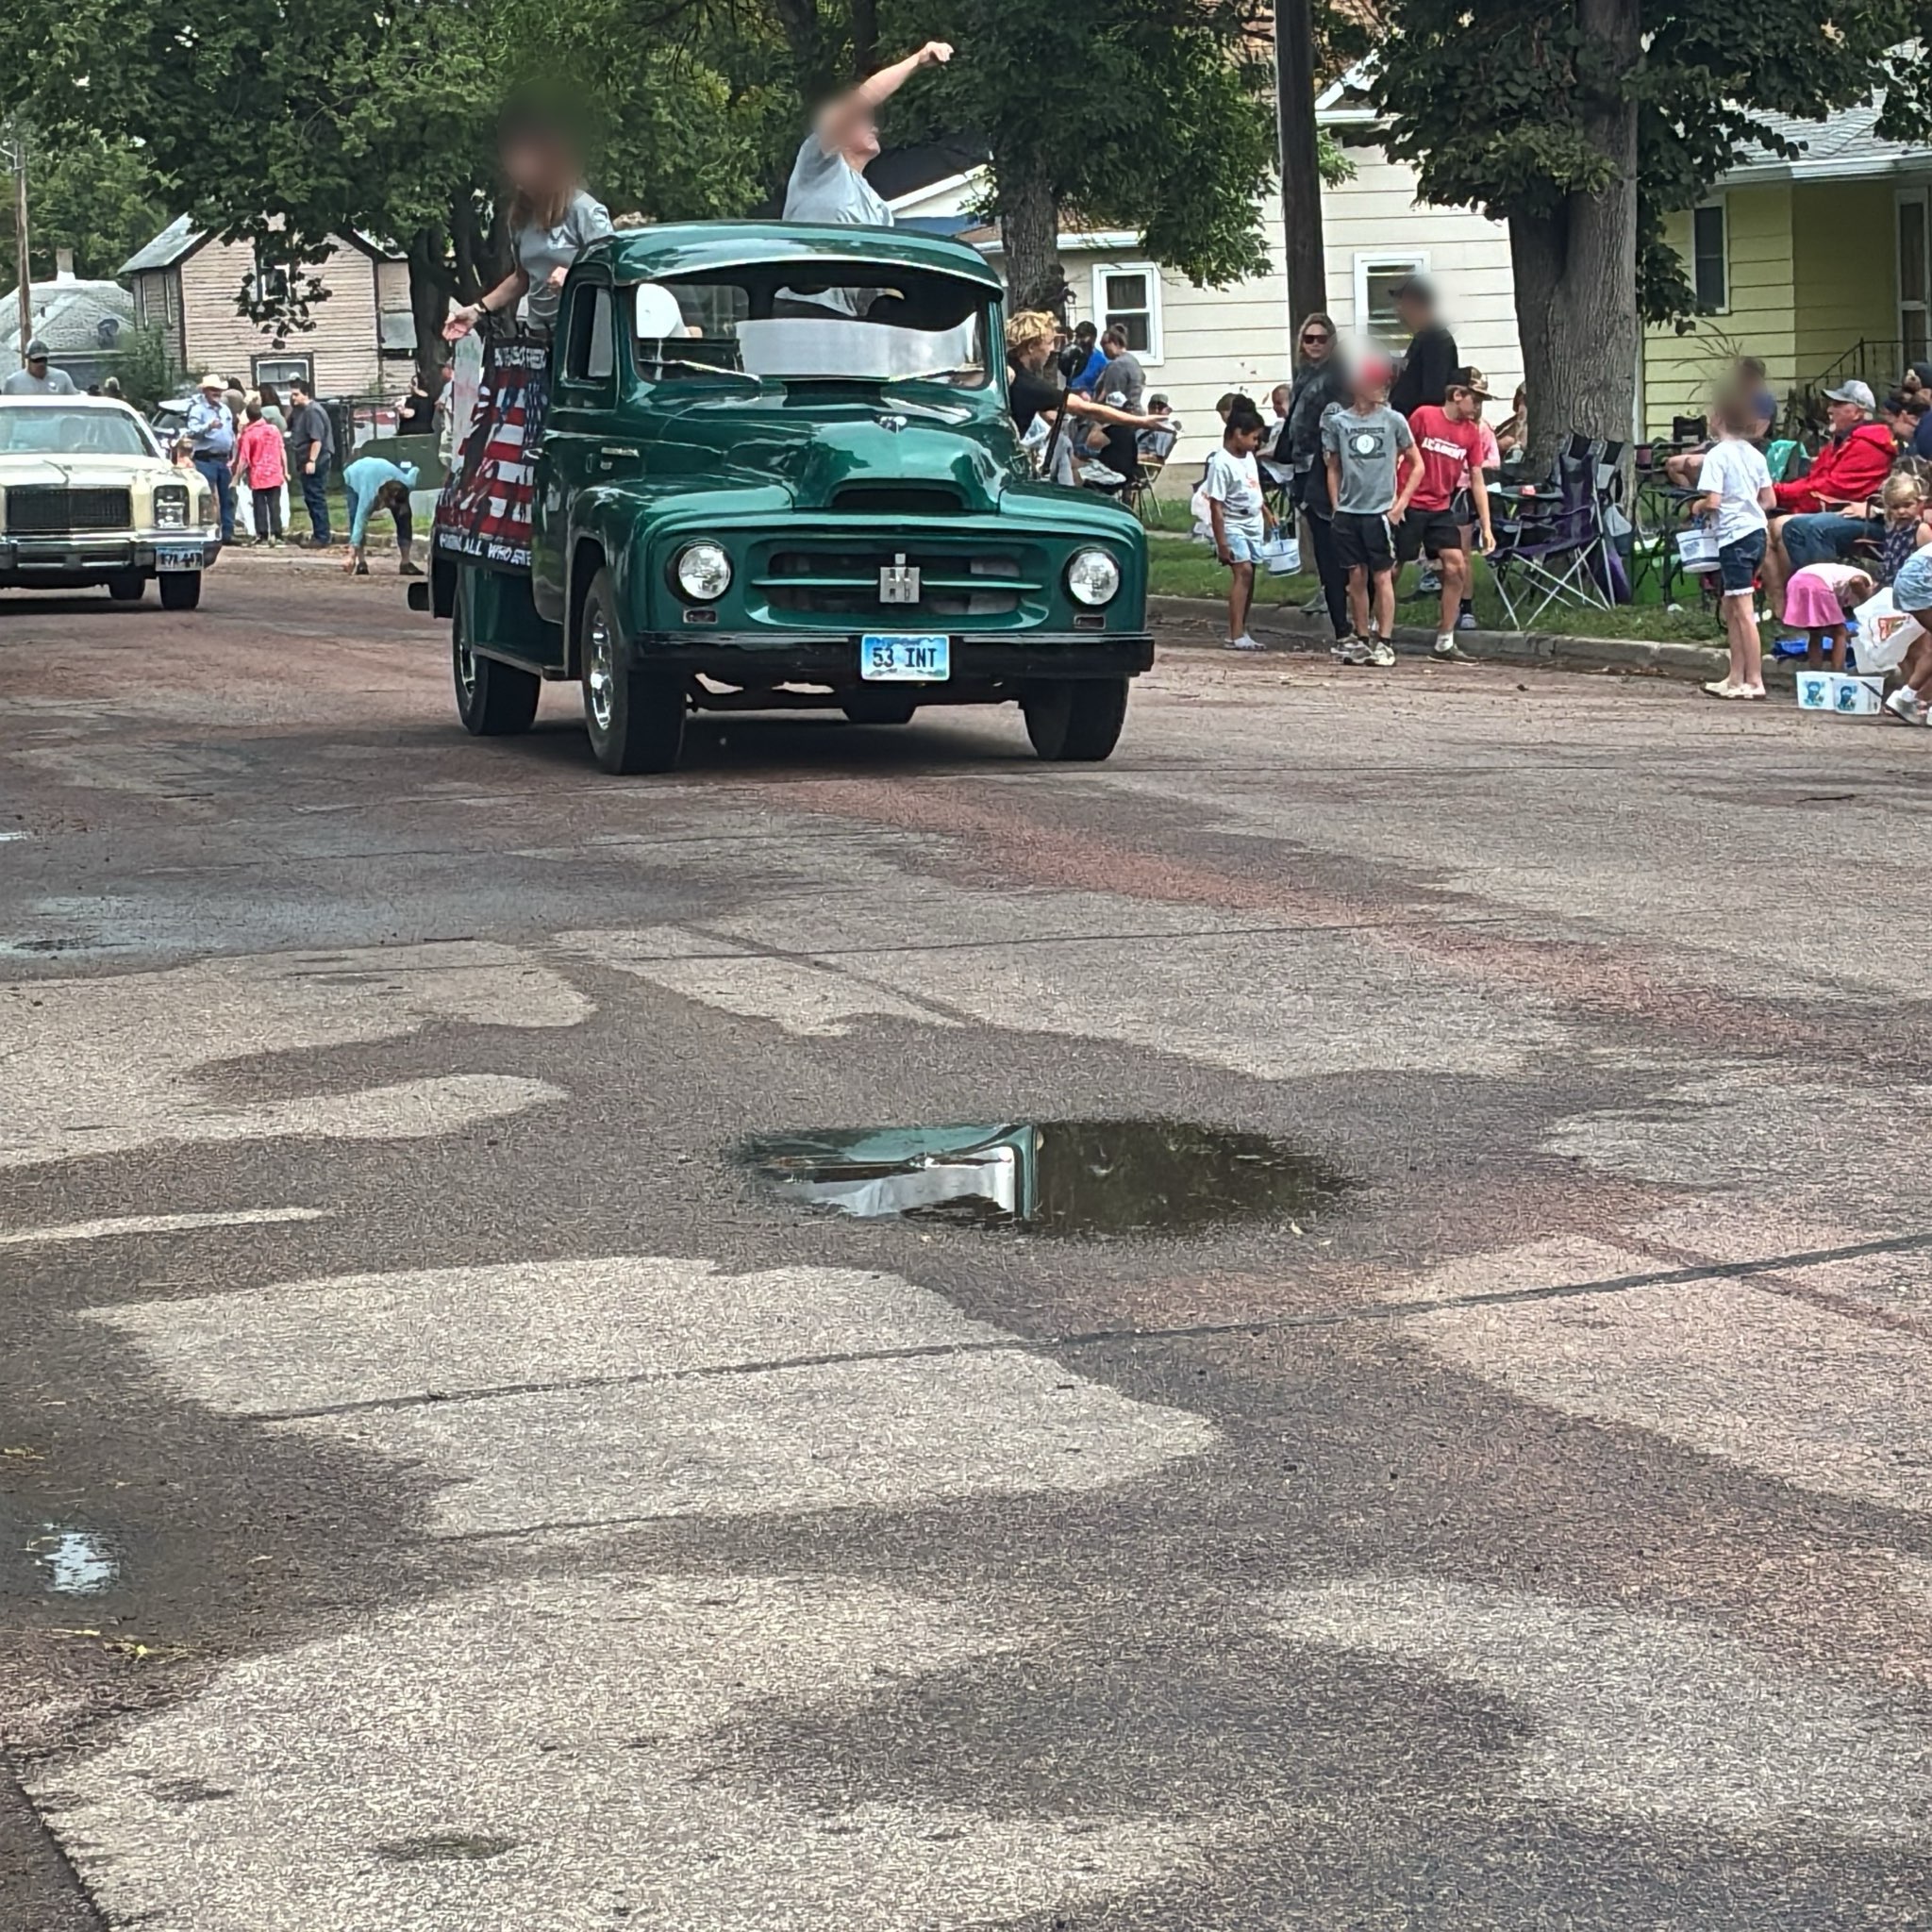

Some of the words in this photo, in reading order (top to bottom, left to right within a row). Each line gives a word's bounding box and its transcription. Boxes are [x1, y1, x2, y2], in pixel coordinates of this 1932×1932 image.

[463, 537, 482, 556] ALL
[873, 647, 894, 668] 53
[905, 647, 937, 668] INT
